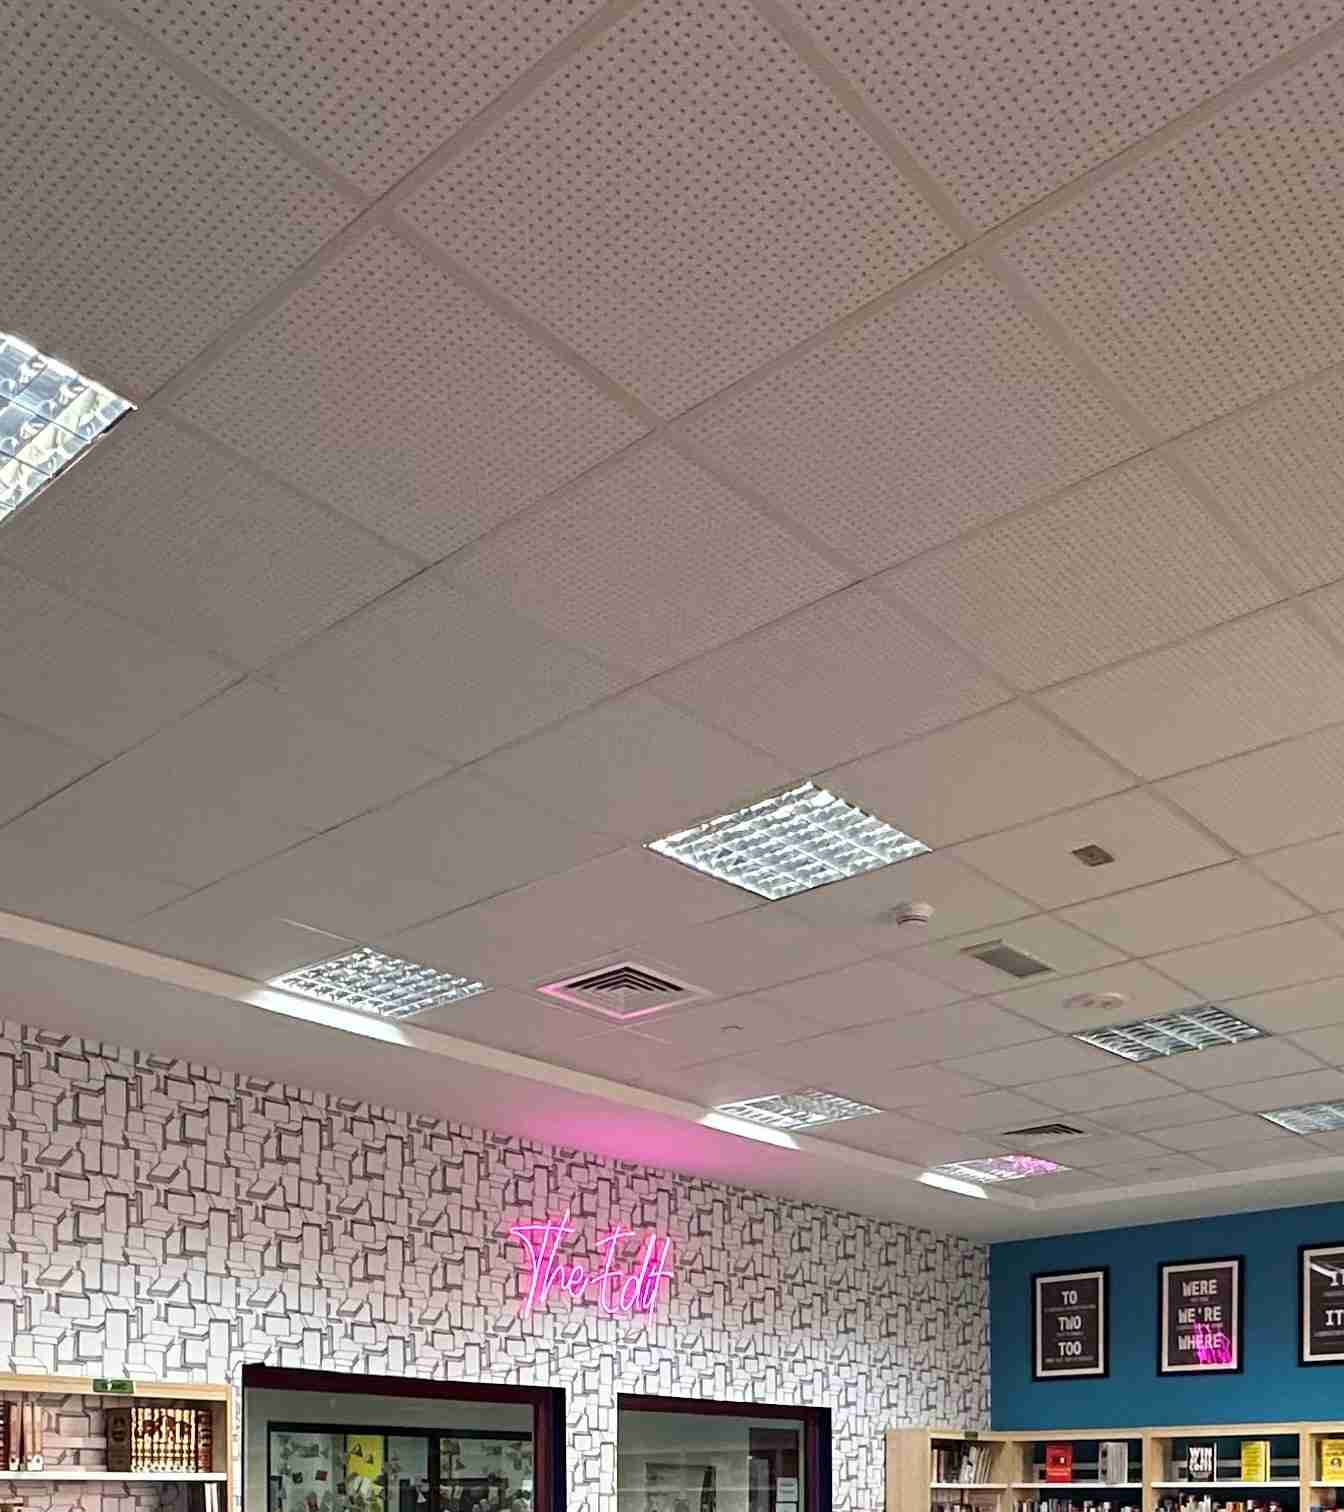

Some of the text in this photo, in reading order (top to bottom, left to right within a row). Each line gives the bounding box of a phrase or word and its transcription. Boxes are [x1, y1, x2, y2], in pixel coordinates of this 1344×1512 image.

[511, 1208, 586, 1320] The
[1182, 1279, 1218, 1297] WERE
[1061, 1290, 1078, 1305] TO
[1057, 1315, 1082, 1331] TWO
[1178, 1306, 1222, 1323] WE'RE
[1058, 1341, 1082, 1356] TOO
[1178, 1333, 1222, 1350] WHERE
